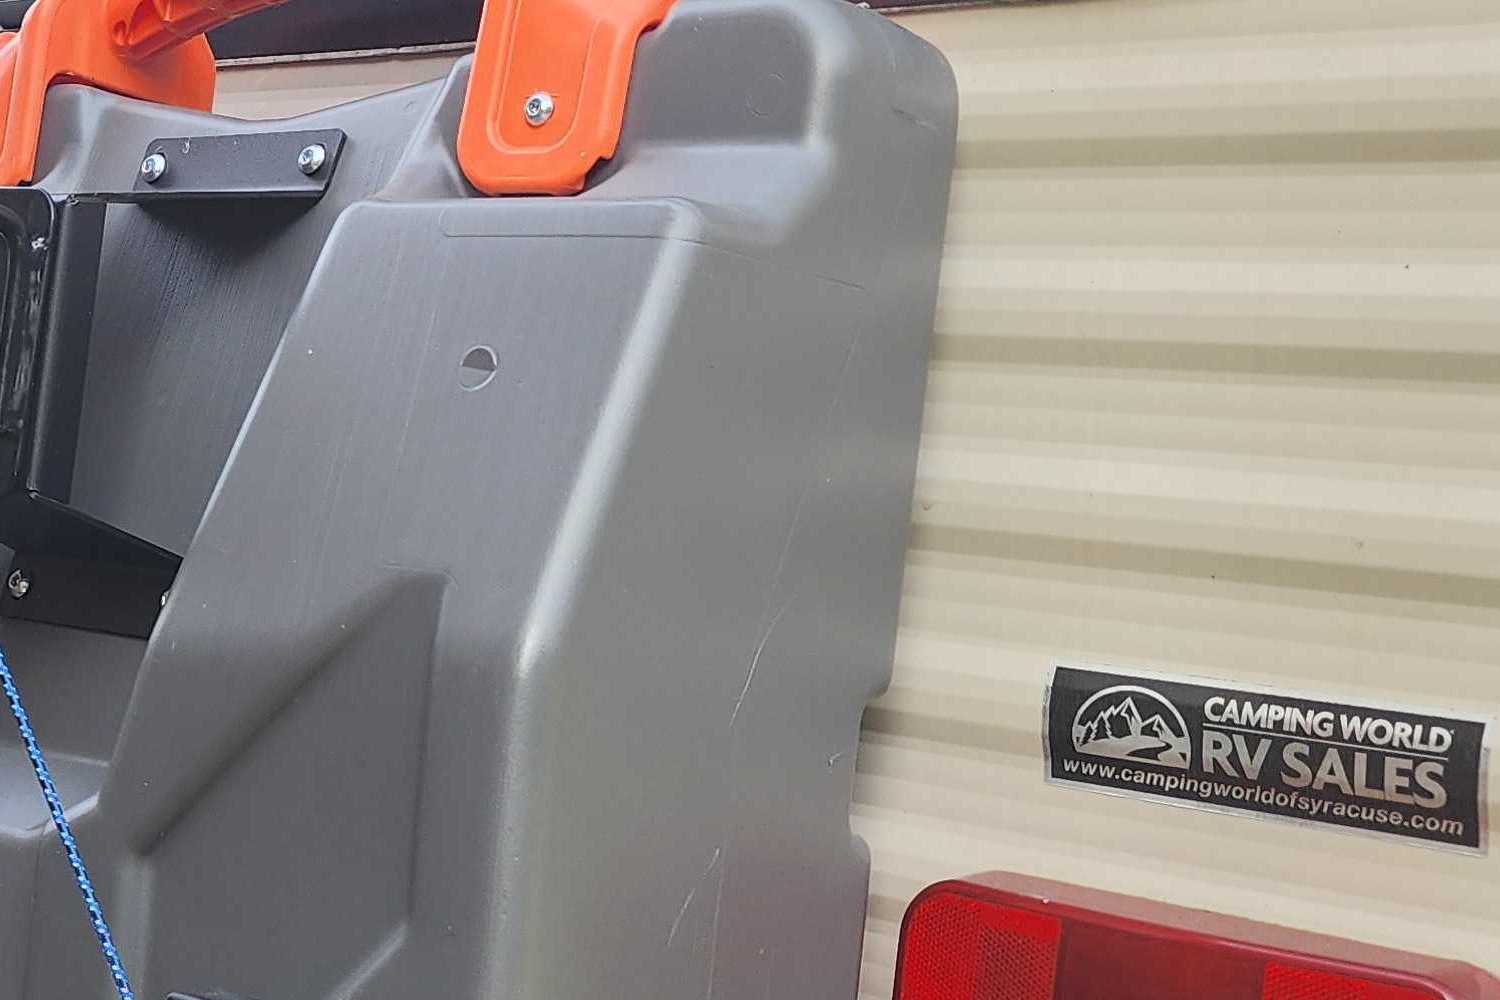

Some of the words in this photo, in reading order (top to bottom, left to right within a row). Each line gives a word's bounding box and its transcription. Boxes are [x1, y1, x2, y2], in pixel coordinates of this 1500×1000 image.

[1204, 695, 1336, 736] CAMPING
[1339, 715, 1450, 751] WORLD
[1063, 758, 1464, 836] www.campingworldofsyracuse.com
[1203, 730, 1271, 781] RV
[1281, 744, 1447, 808] SALES
